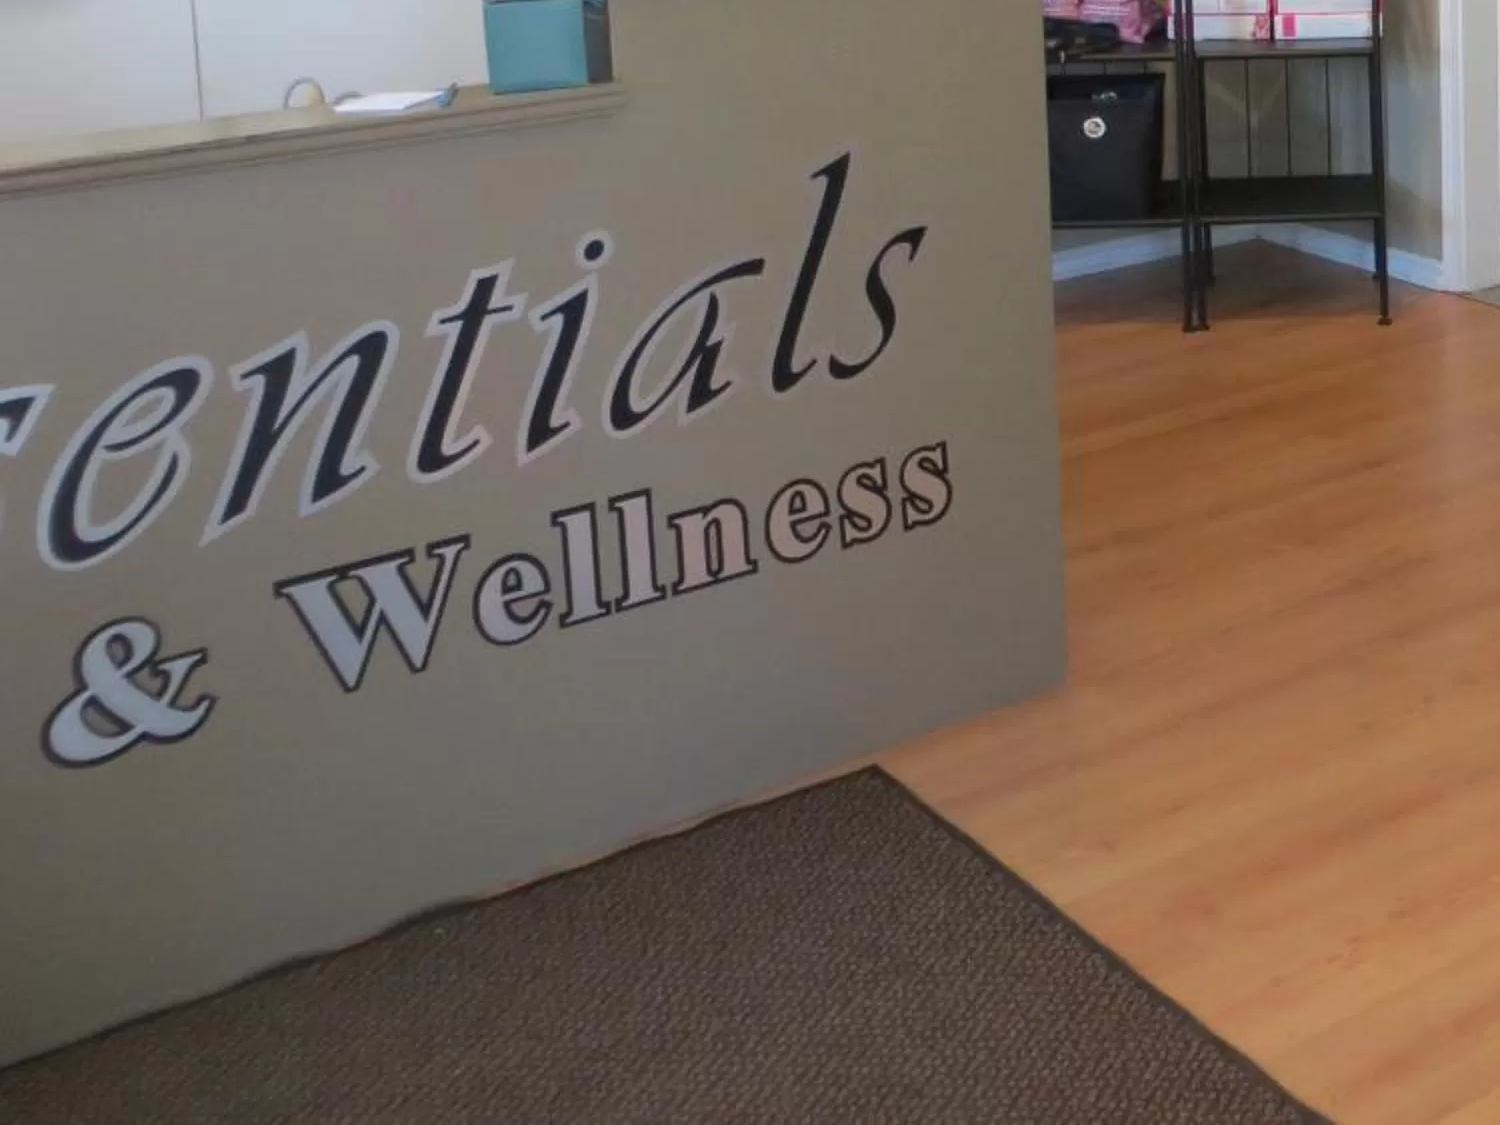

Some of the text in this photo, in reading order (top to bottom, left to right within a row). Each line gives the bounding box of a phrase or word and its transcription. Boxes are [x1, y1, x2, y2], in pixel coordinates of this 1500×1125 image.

[0, 149, 928, 572] entials
[40, 441, 955, 769] & Wellness
